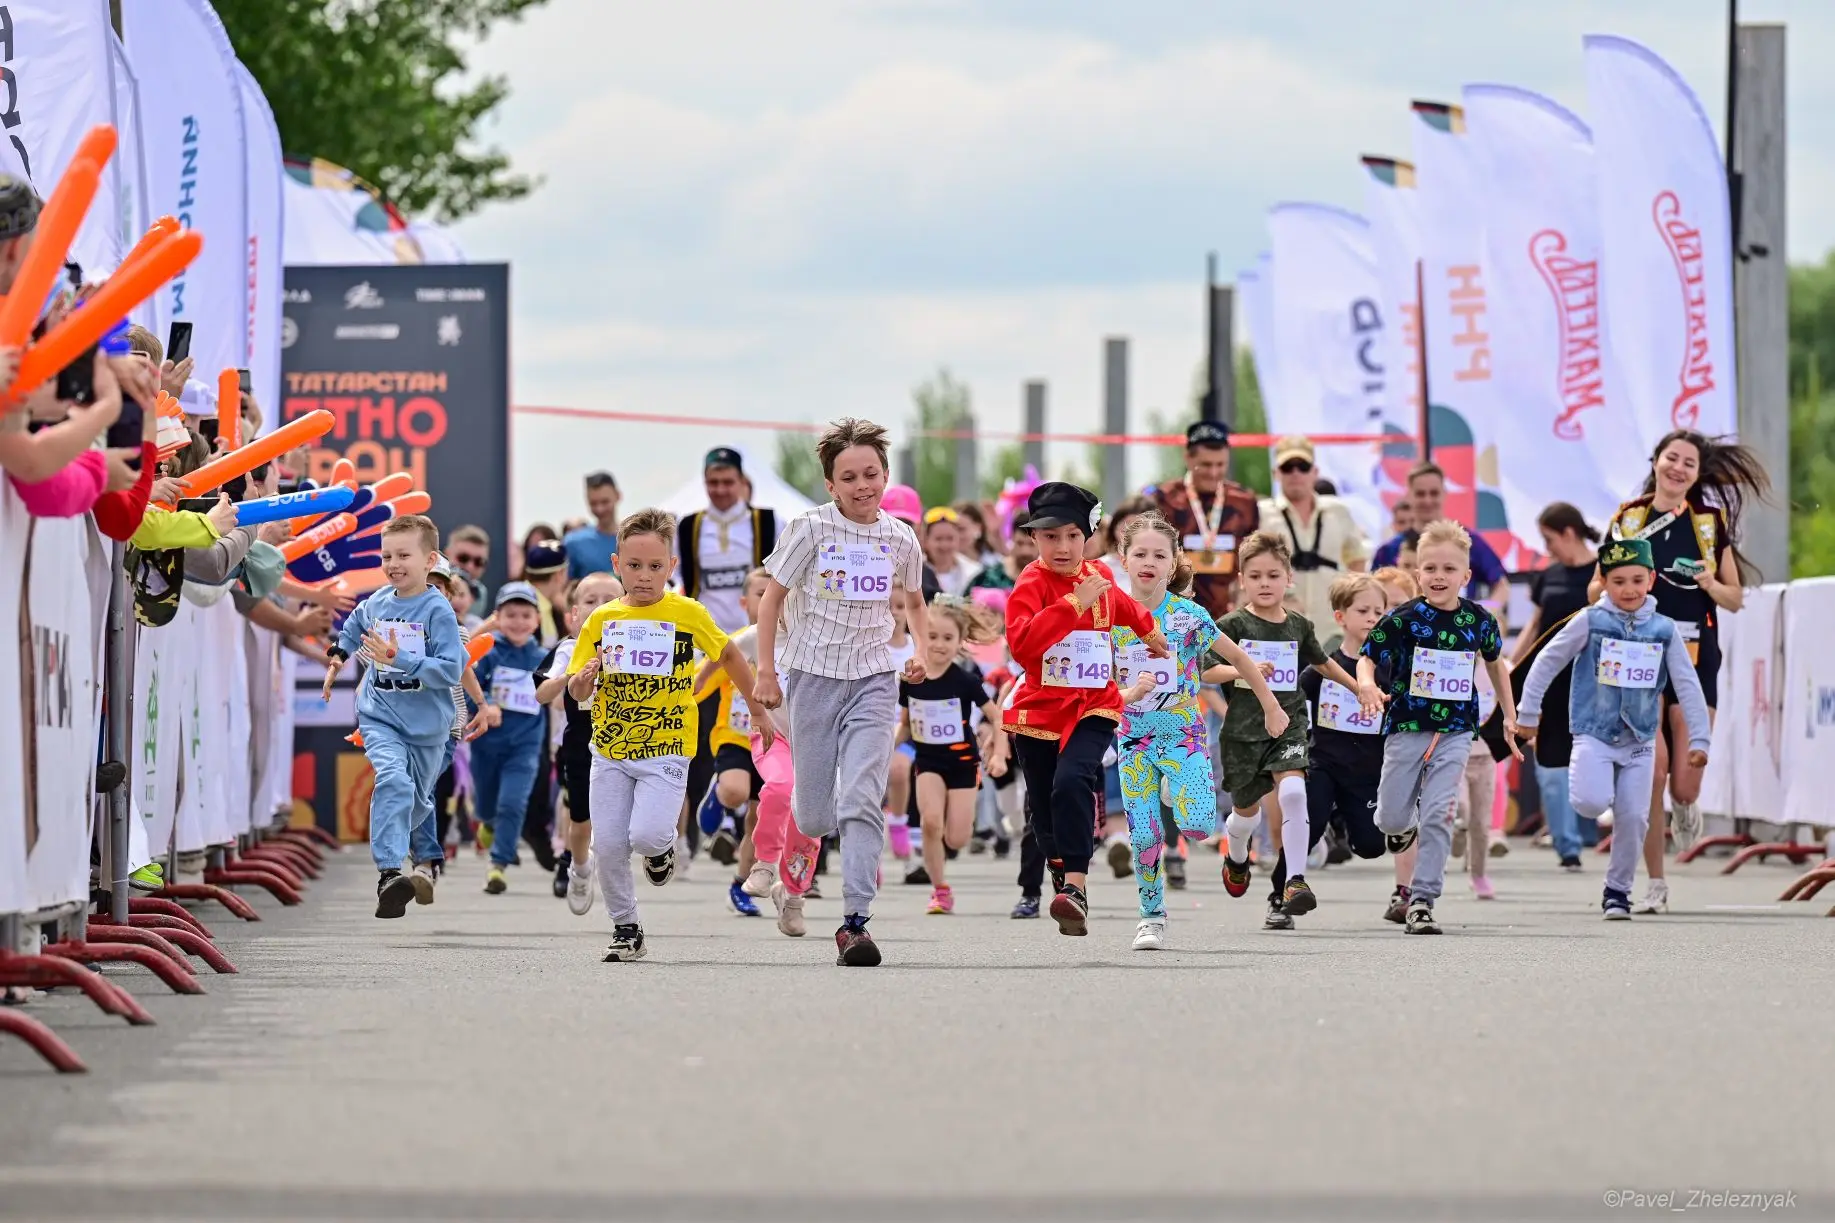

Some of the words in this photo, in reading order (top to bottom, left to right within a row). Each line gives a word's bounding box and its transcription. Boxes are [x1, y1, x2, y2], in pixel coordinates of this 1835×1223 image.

[286, 372, 448, 393] ТАТАРСТАН
[851, 576, 888, 592] 105
[630, 650, 668, 667] 167
[1076, 663, 1109, 679] 148
[1626, 668, 1654, 681] 136
[1439, 678, 1469, 692] 106
[1346, 712, 1373, 727] 45
[931, 724, 956, 737] 80
